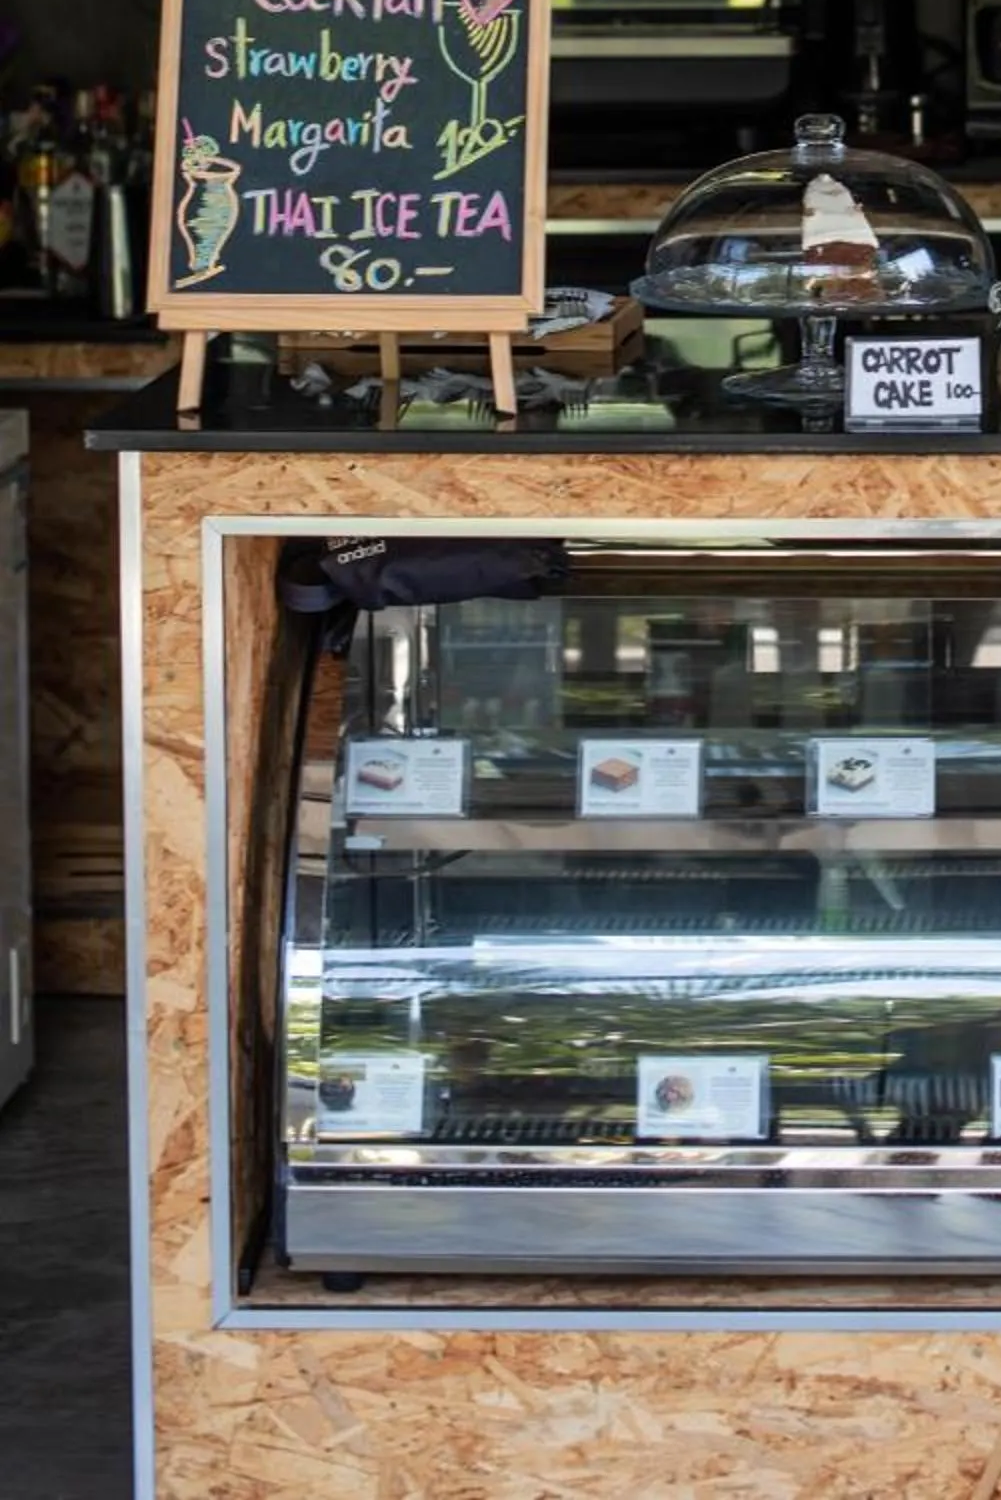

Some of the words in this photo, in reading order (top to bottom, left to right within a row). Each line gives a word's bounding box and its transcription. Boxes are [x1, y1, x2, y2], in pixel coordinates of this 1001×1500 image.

[229, 98, 414, 176] Margarita
[244, 187, 339, 241] THAI
[351, 187, 421, 240] ICE
[430, 190, 512, 242] TEA
[862, 346, 962, 375] CARROT
[874, 380, 933, 409] CAKE
